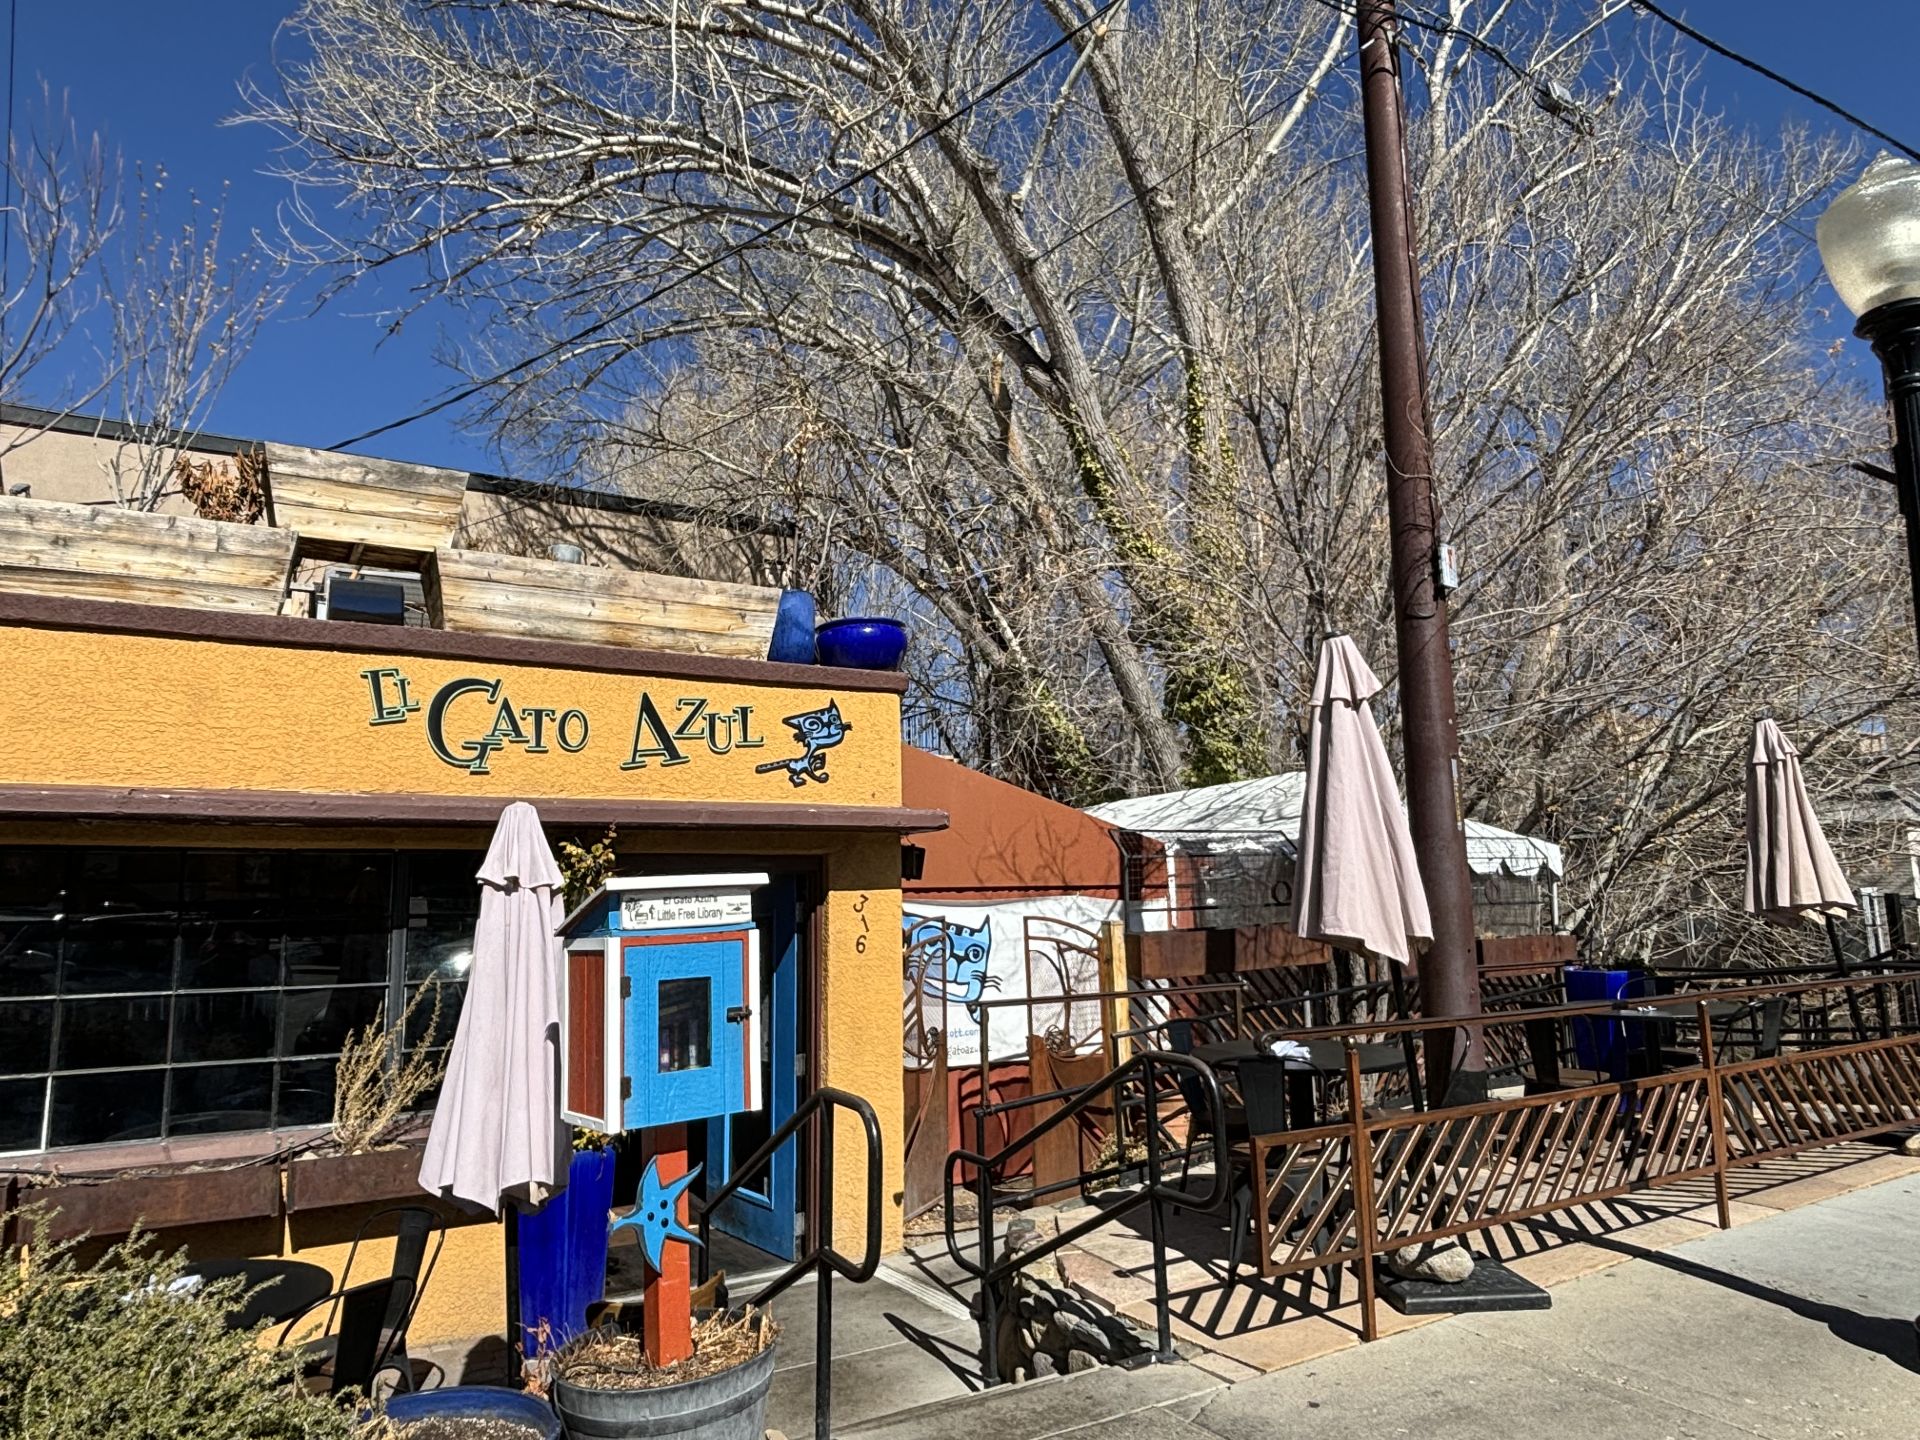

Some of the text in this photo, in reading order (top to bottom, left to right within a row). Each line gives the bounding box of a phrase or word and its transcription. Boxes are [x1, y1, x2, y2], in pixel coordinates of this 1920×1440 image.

[361, 668, 765, 775] EL GATO AZUL
[657, 907, 724, 921] Little Free Library
